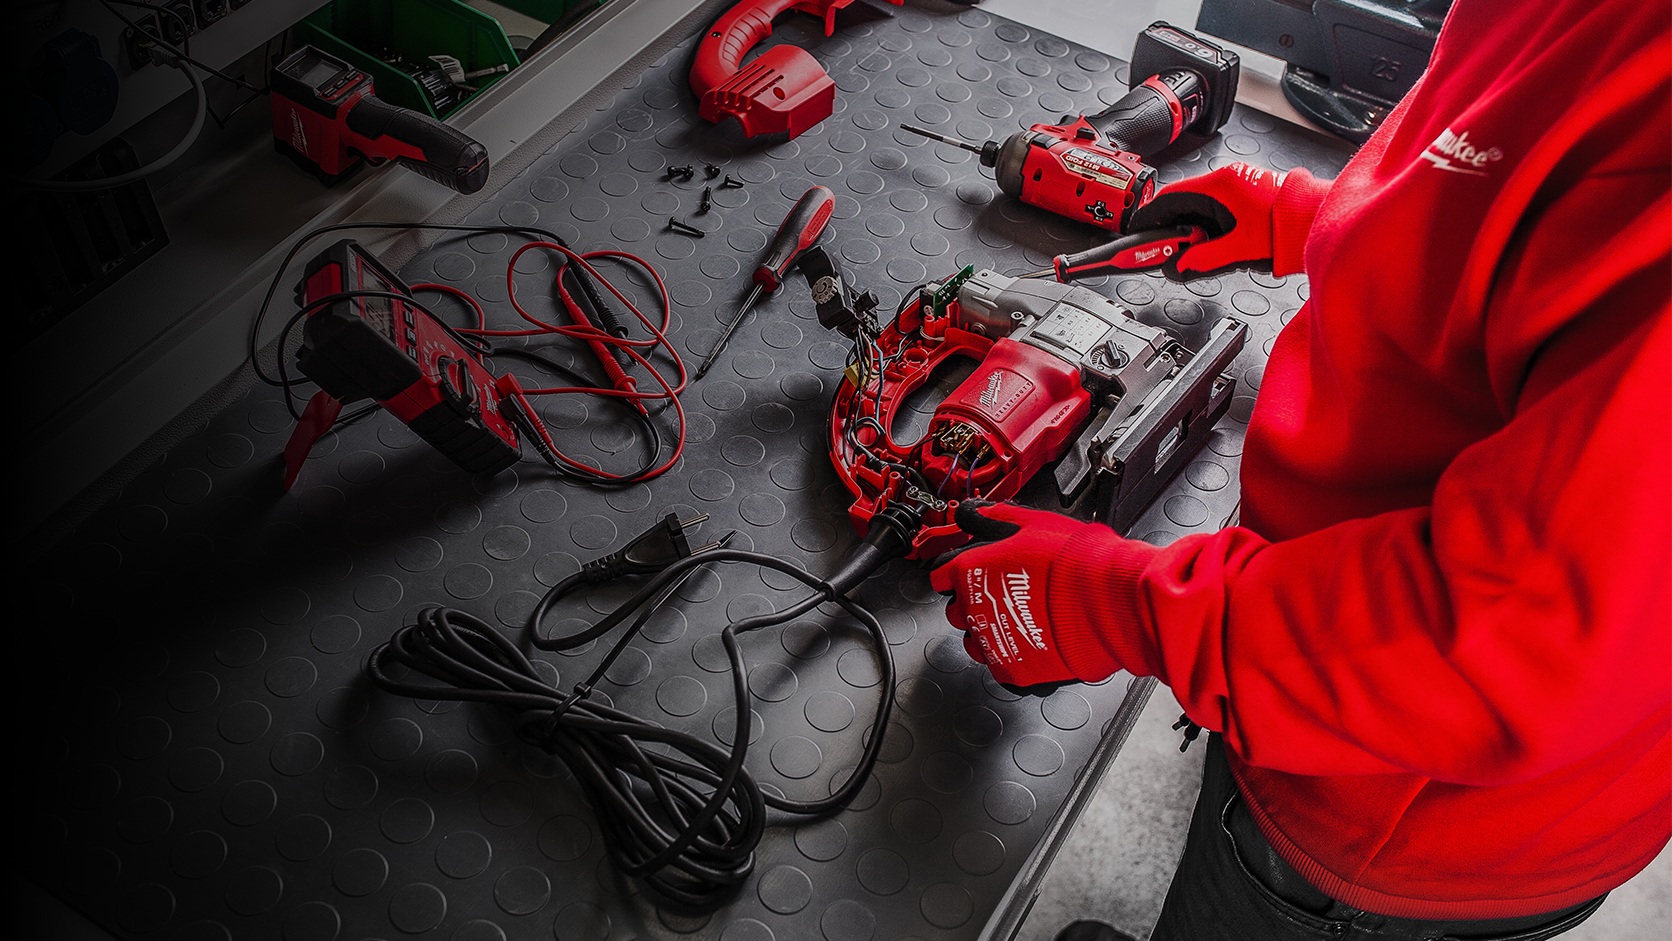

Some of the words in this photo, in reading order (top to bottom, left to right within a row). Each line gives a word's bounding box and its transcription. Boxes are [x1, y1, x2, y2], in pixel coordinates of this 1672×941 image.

[34, 10, 62, 34] R6/1
[1084, 160, 1101, 171] M12
[979, 370, 1003, 409] Milwaukee
[1006, 567, 1045, 650] Milwaukee
[1000, 613, 1010, 630] CUT
[1006, 632, 1020, 656] LEVEL
